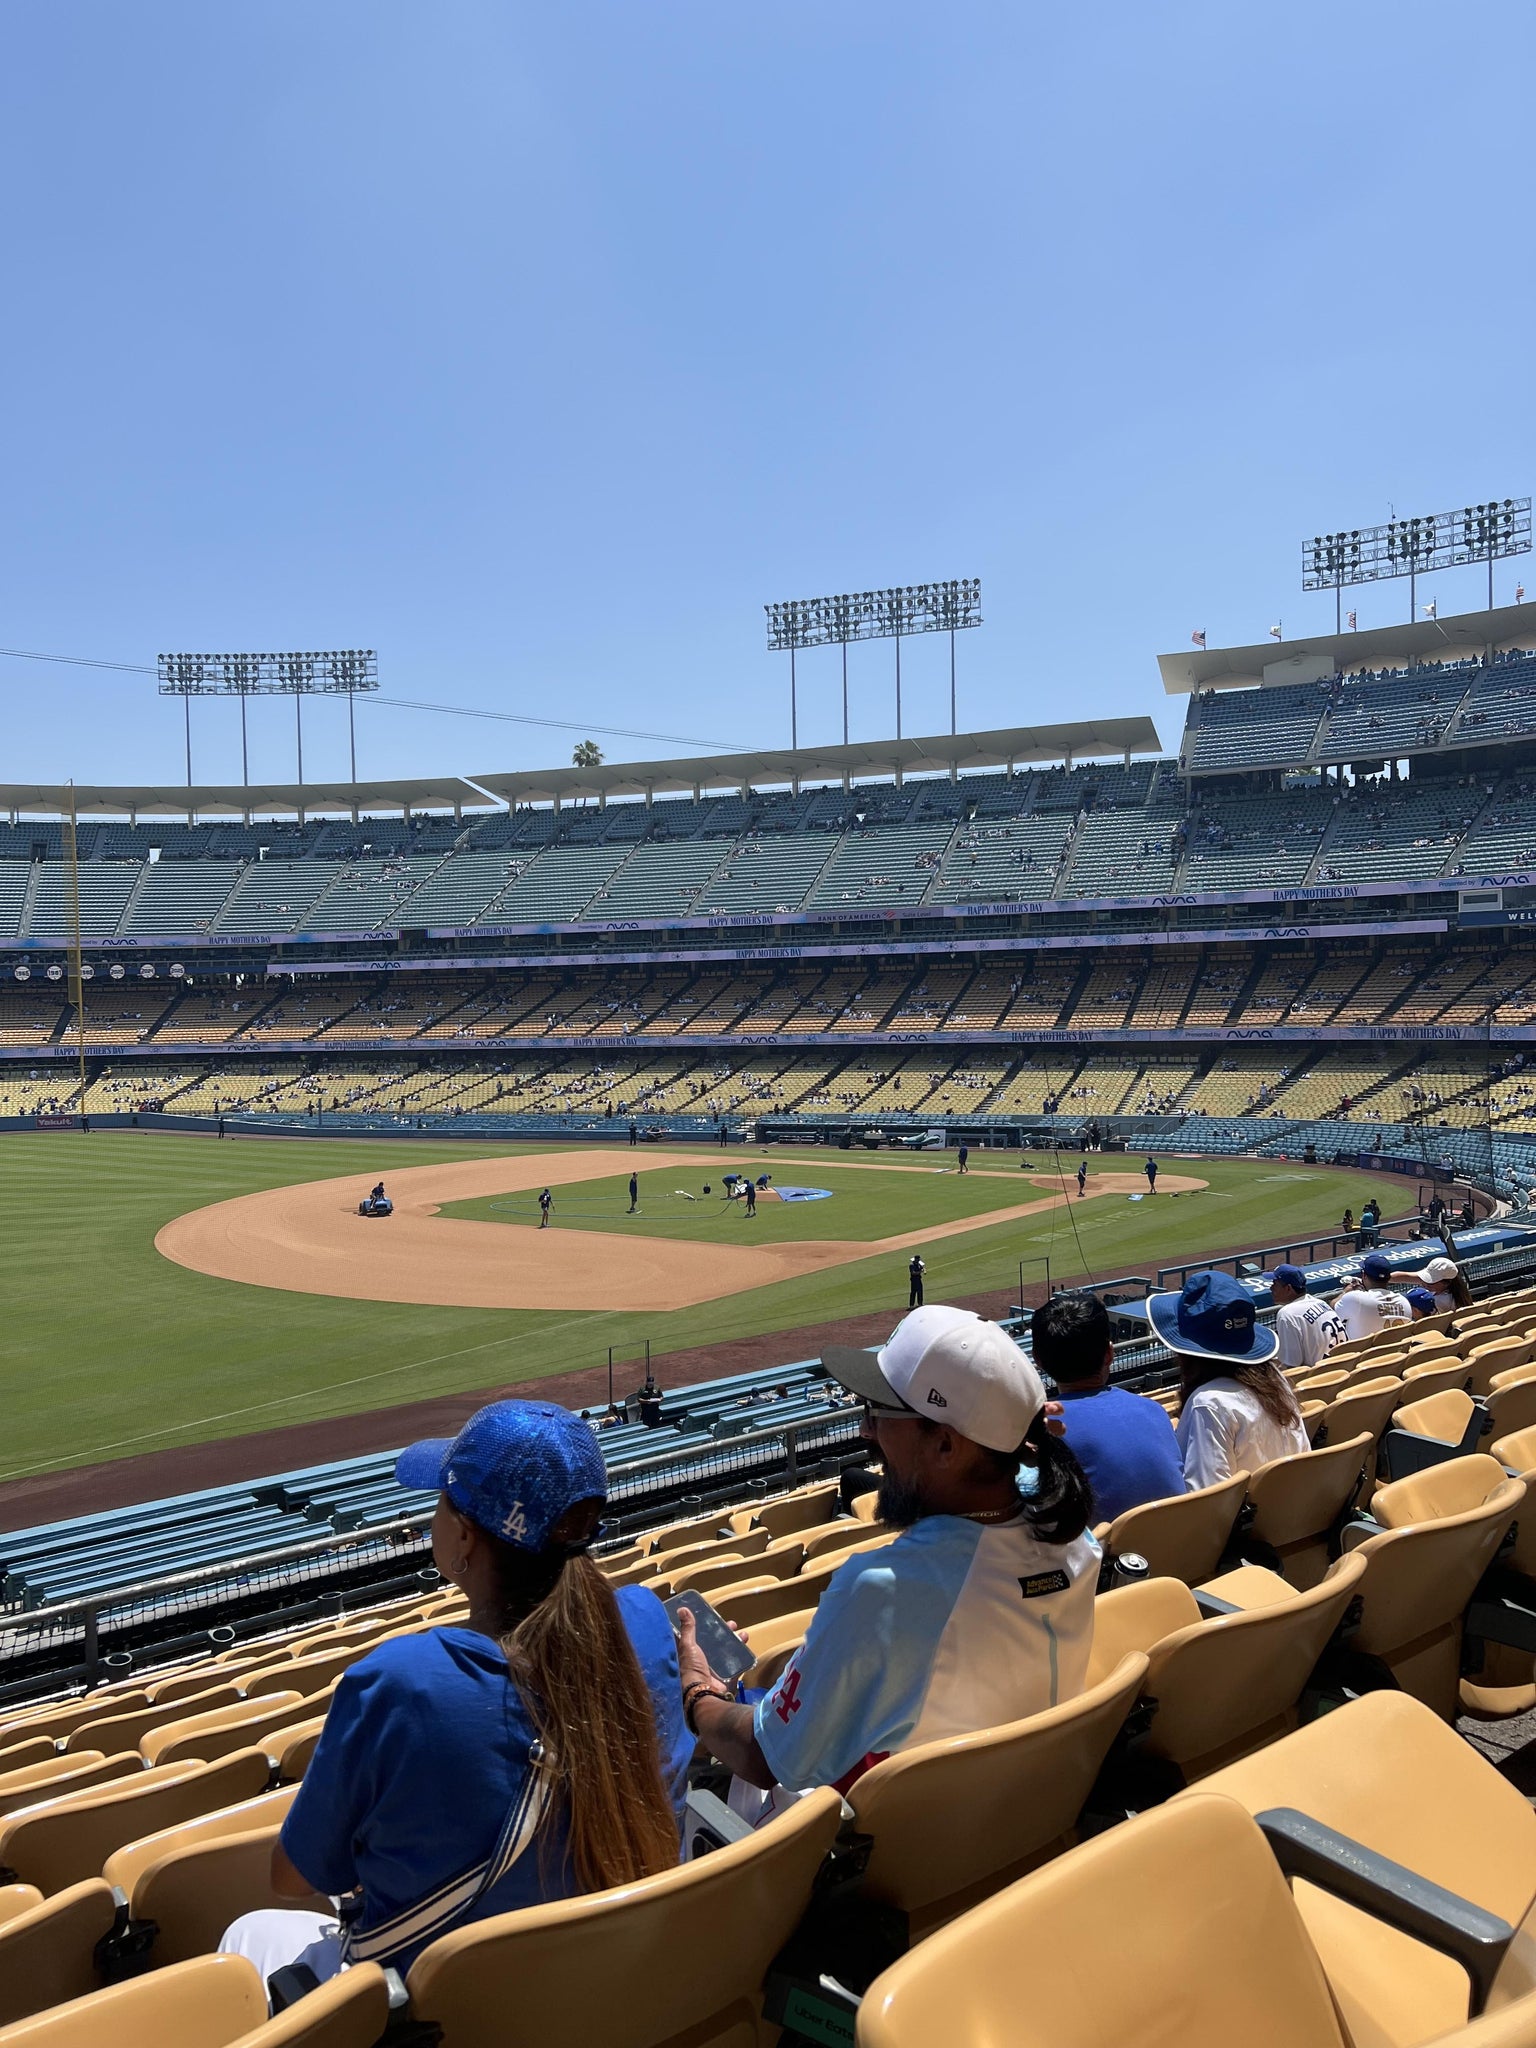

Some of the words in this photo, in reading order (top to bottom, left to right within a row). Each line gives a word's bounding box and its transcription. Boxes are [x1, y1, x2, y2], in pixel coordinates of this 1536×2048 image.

[1273, 891, 1298, 900] HAPPY
[1302, 889, 1342, 899] MOTHER'S
[1344, 887, 1359, 896] DAY
[968, 906, 990, 915] HAPPY
[1030, 903, 1043, 912] DAY
[708, 918, 728, 926] HAPPY
[736, 950, 756, 958] HAPPY
[1012, 1033, 1035, 1041] HAPPY
[1079, 1031, 1093, 1040] DAY
[1370, 1029, 1398, 1039] HAPPY
[1401, 1028, 1444, 1039] MOTHER'S
[1446, 1028, 1462, 1038] DAY
[574, 1038, 592, 1046] HAPPY
[1377, 1303, 1404, 1316] SMITH
[1322, 1317, 1348, 1348] 35
[502, 1500, 528, 1541] LA
[795, 2005, 824, 2024] Uber
